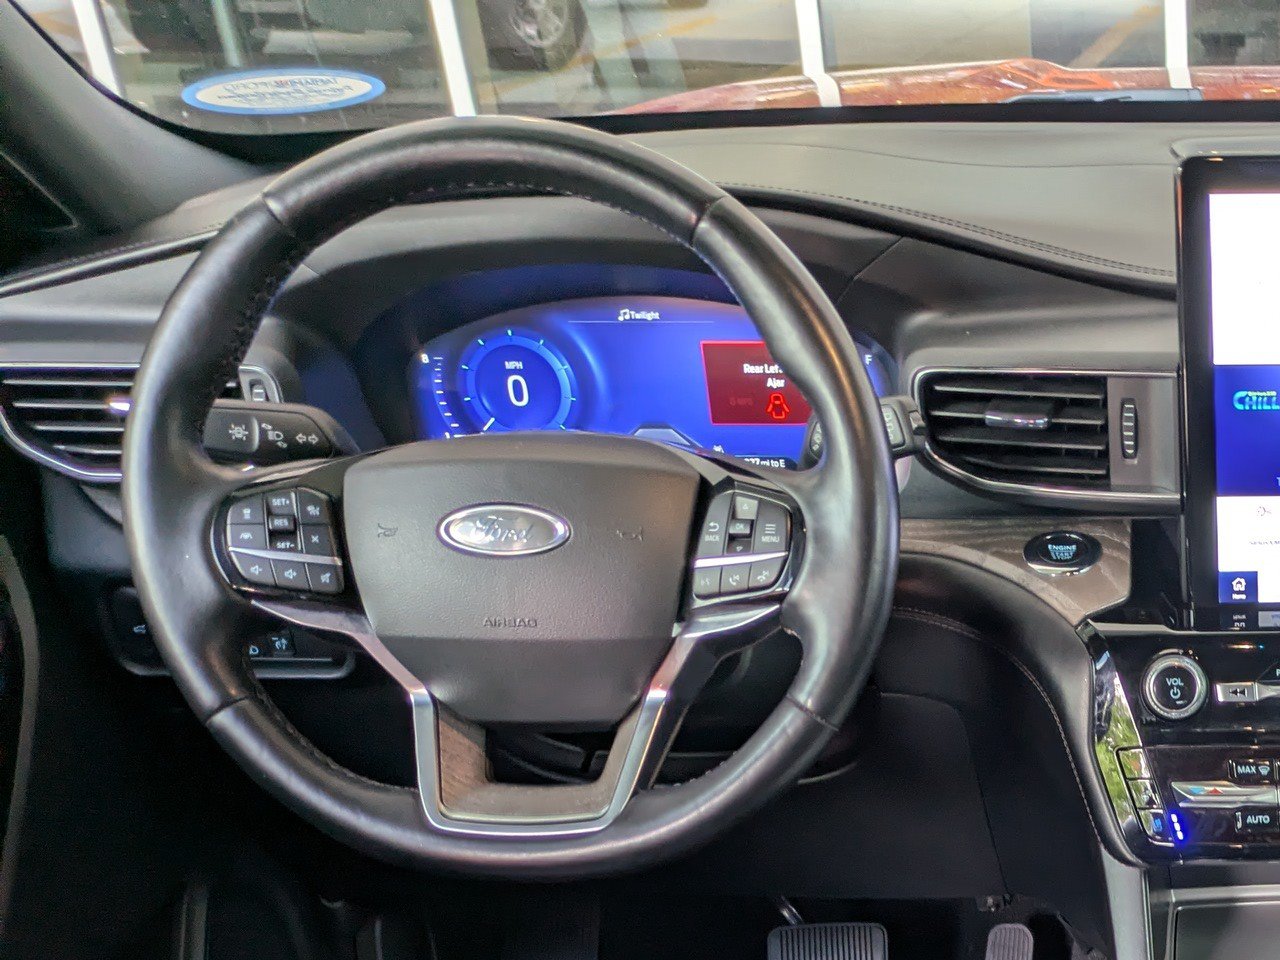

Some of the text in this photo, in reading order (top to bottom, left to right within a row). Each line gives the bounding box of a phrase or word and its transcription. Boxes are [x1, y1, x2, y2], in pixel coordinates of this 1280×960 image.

[630, 310, 660, 321] Twilight
[864, 354, 872, 365] F
[504, 361, 524, 370] MPH
[743, 363, 764, 374] Rear
[766, 377, 786, 389] Ajar
[507, 374, 529, 407] 0
[1233, 390, 1280, 410] CHILL
[770, 459, 779, 468] to
[779, 459, 786, 468] E
[274, 518, 289, 527] RES
[735, 523, 745, 531] OK
[704, 534, 720, 542] BACK
[761, 535, 780, 543] MENU
[1165, 677, 1184, 687] VOL
[1237, 765, 1257, 774] MAX
[1246, 813, 1270, 824] AUTO
